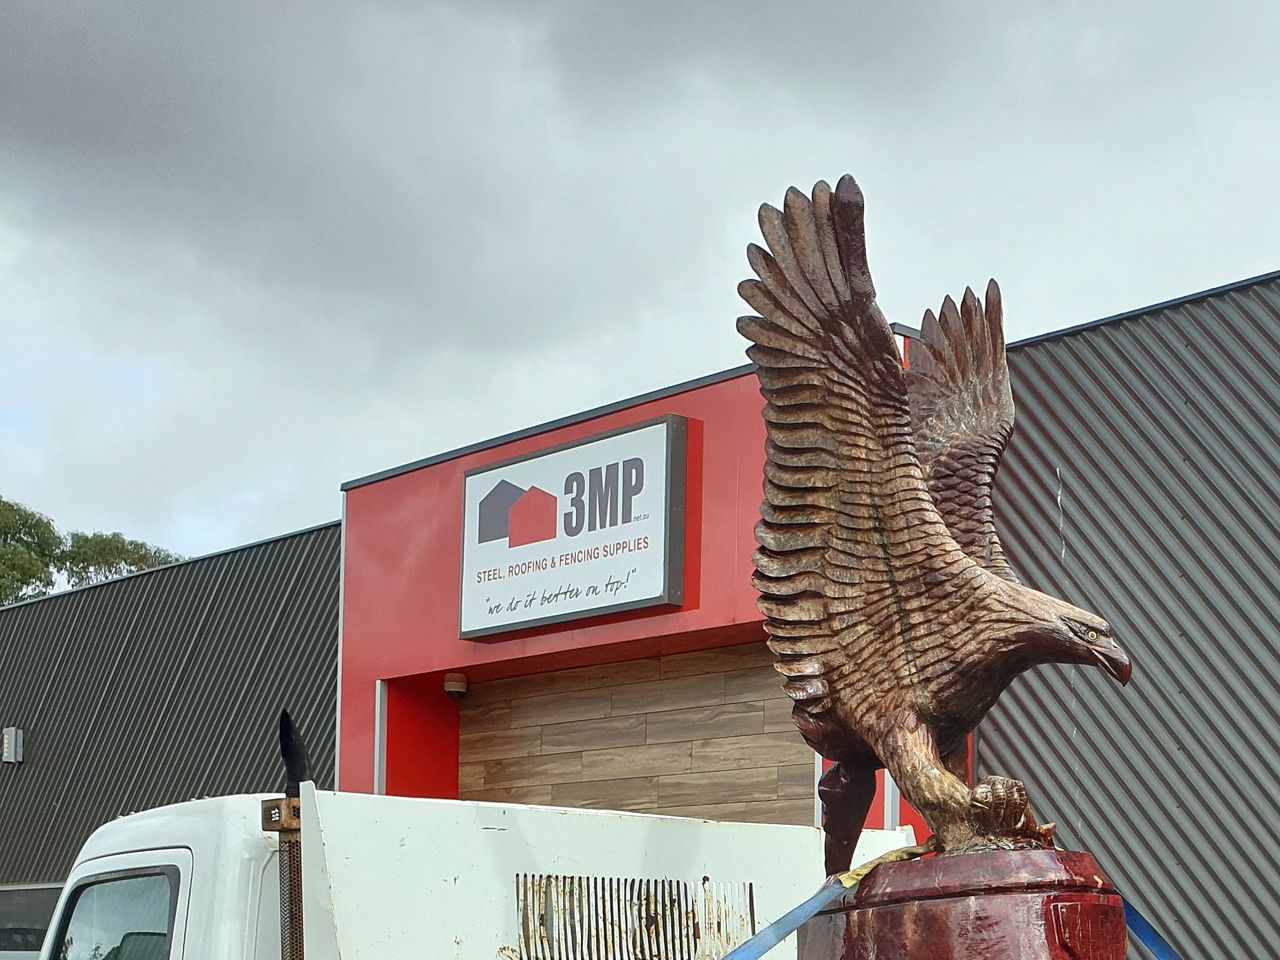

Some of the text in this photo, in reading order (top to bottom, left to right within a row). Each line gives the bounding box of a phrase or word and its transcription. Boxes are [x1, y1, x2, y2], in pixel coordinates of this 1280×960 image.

[563, 457, 645, 537] 3MP
[476, 536, 649, 584] STEEL, ROOFING & FENCING SUPPLIES
[506, 597, 522, 612] do
[524, 591, 537, 608] it
[540, 583, 582, 606] better
[586, 585, 600, 597] on
